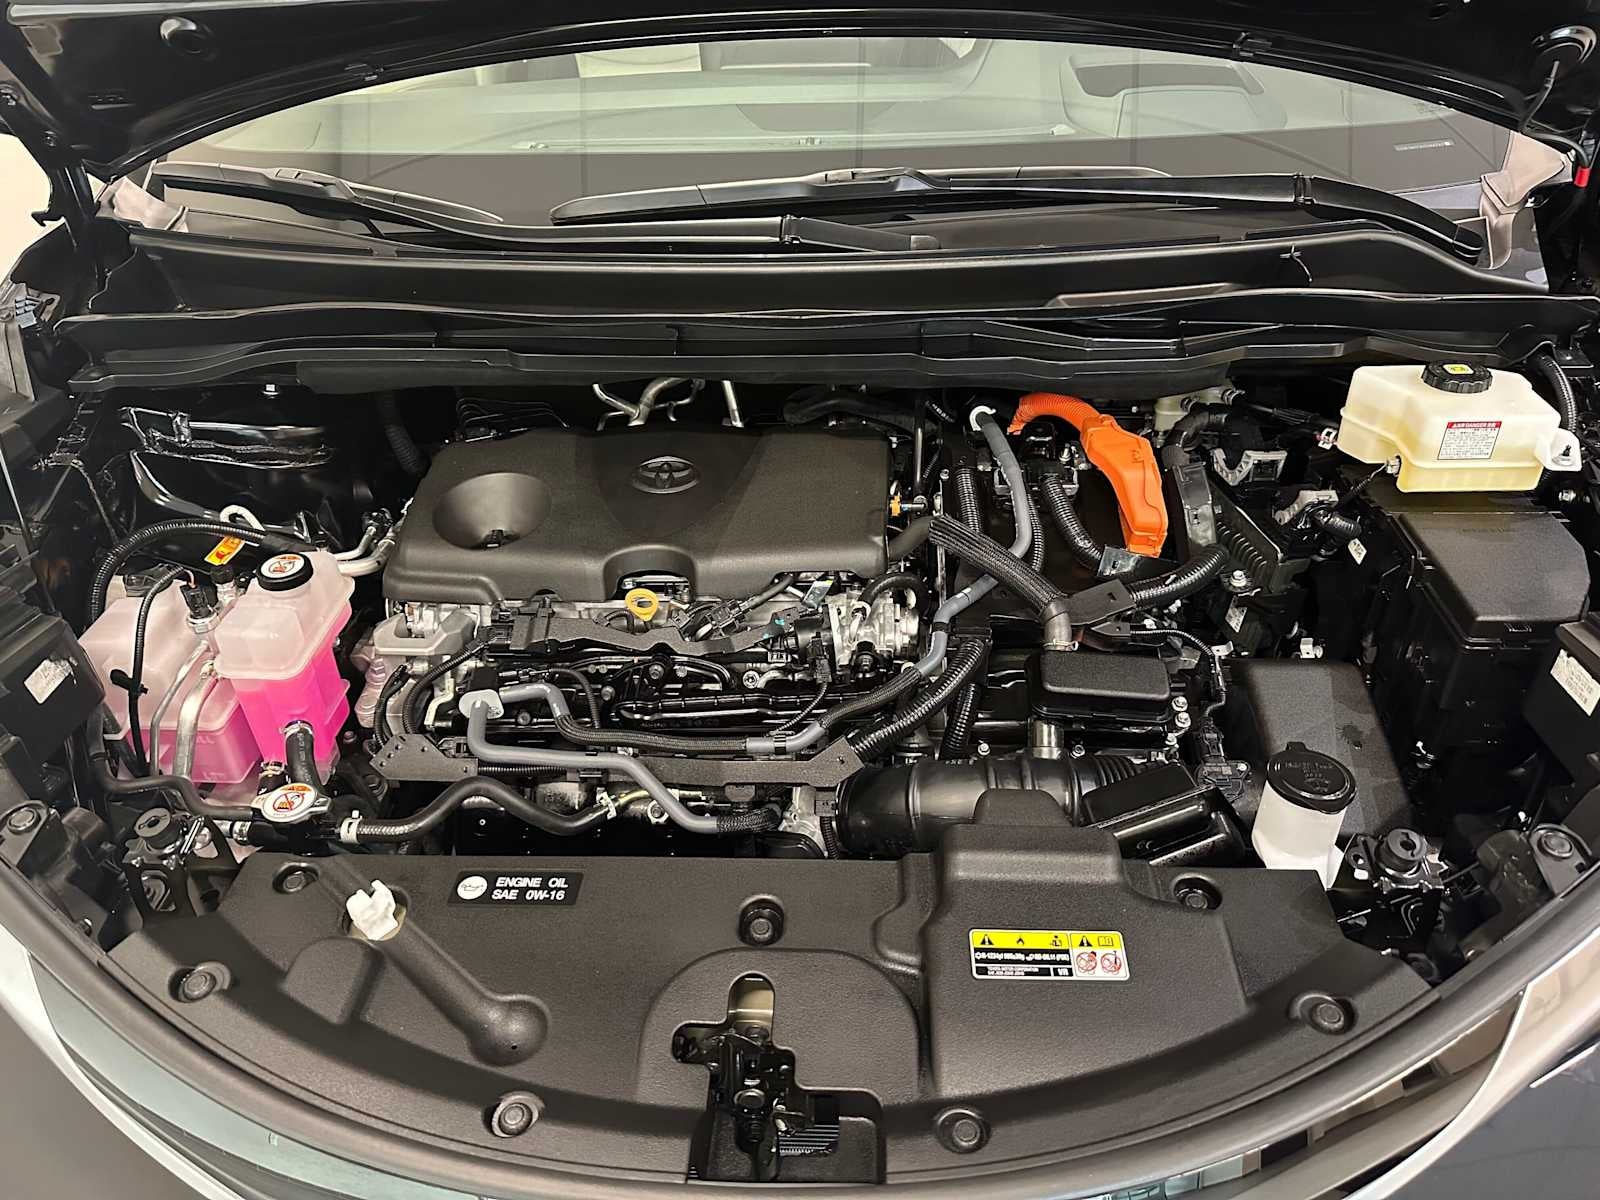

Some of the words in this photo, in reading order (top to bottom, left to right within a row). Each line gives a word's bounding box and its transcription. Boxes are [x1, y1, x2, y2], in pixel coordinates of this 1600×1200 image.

[496, 877, 542, 888] ENGINE
[548, 877, 569, 888] OIL
[492, 889, 519, 900] SAE
[525, 890, 565, 900] 0W-16
